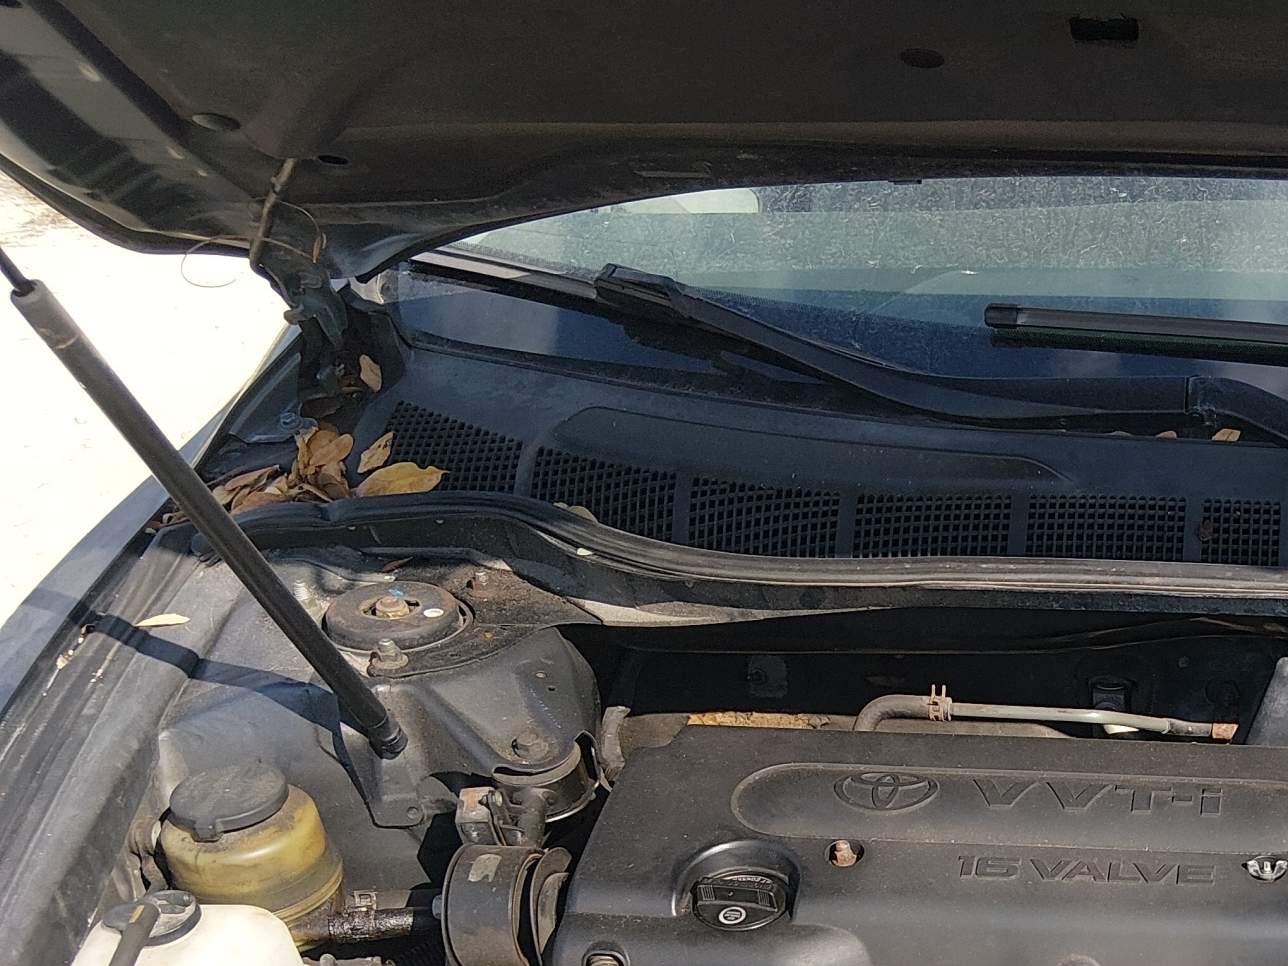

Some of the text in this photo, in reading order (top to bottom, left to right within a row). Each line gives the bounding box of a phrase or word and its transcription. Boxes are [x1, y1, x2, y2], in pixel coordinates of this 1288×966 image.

[973, 779, 1224, 817] VVT-i
[959, 855, 1216, 885] 16 VALVE
